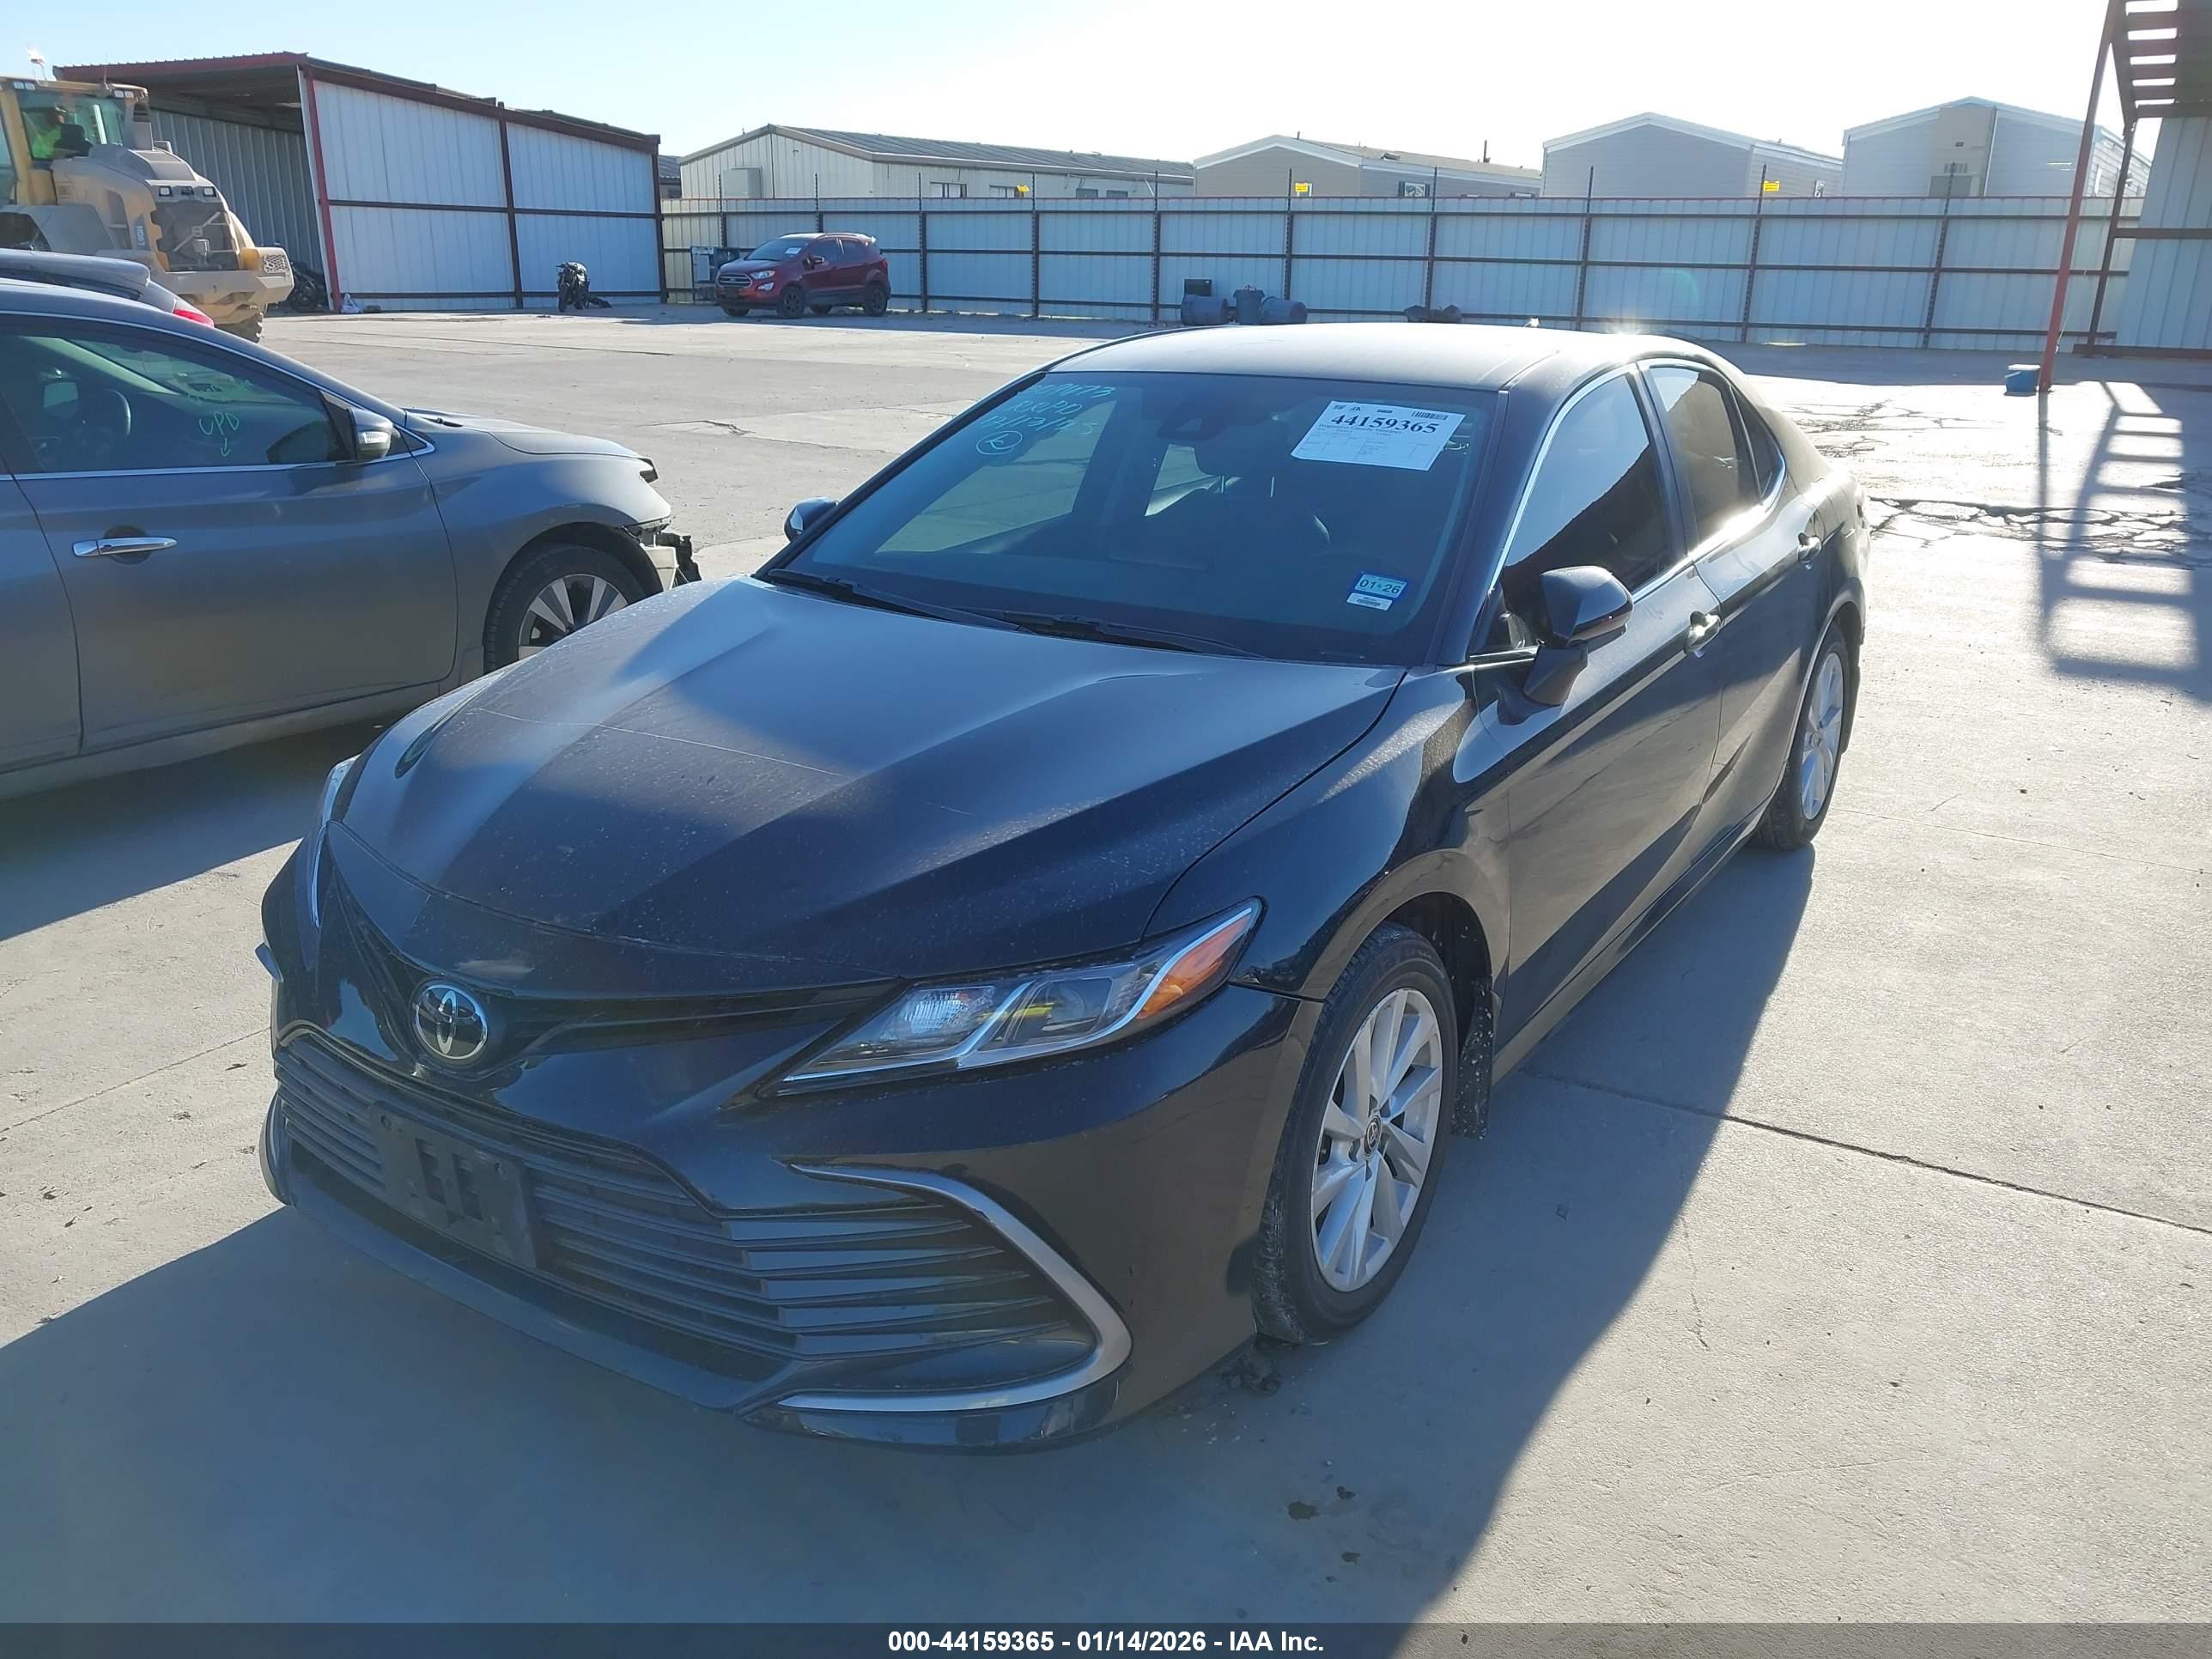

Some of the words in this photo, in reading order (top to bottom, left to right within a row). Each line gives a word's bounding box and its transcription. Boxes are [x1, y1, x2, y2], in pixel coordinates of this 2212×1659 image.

[1331, 413, 1439, 434] 44159365
[1359, 579, 1376, 589] 01
[1382, 583, 1401, 594] 26
